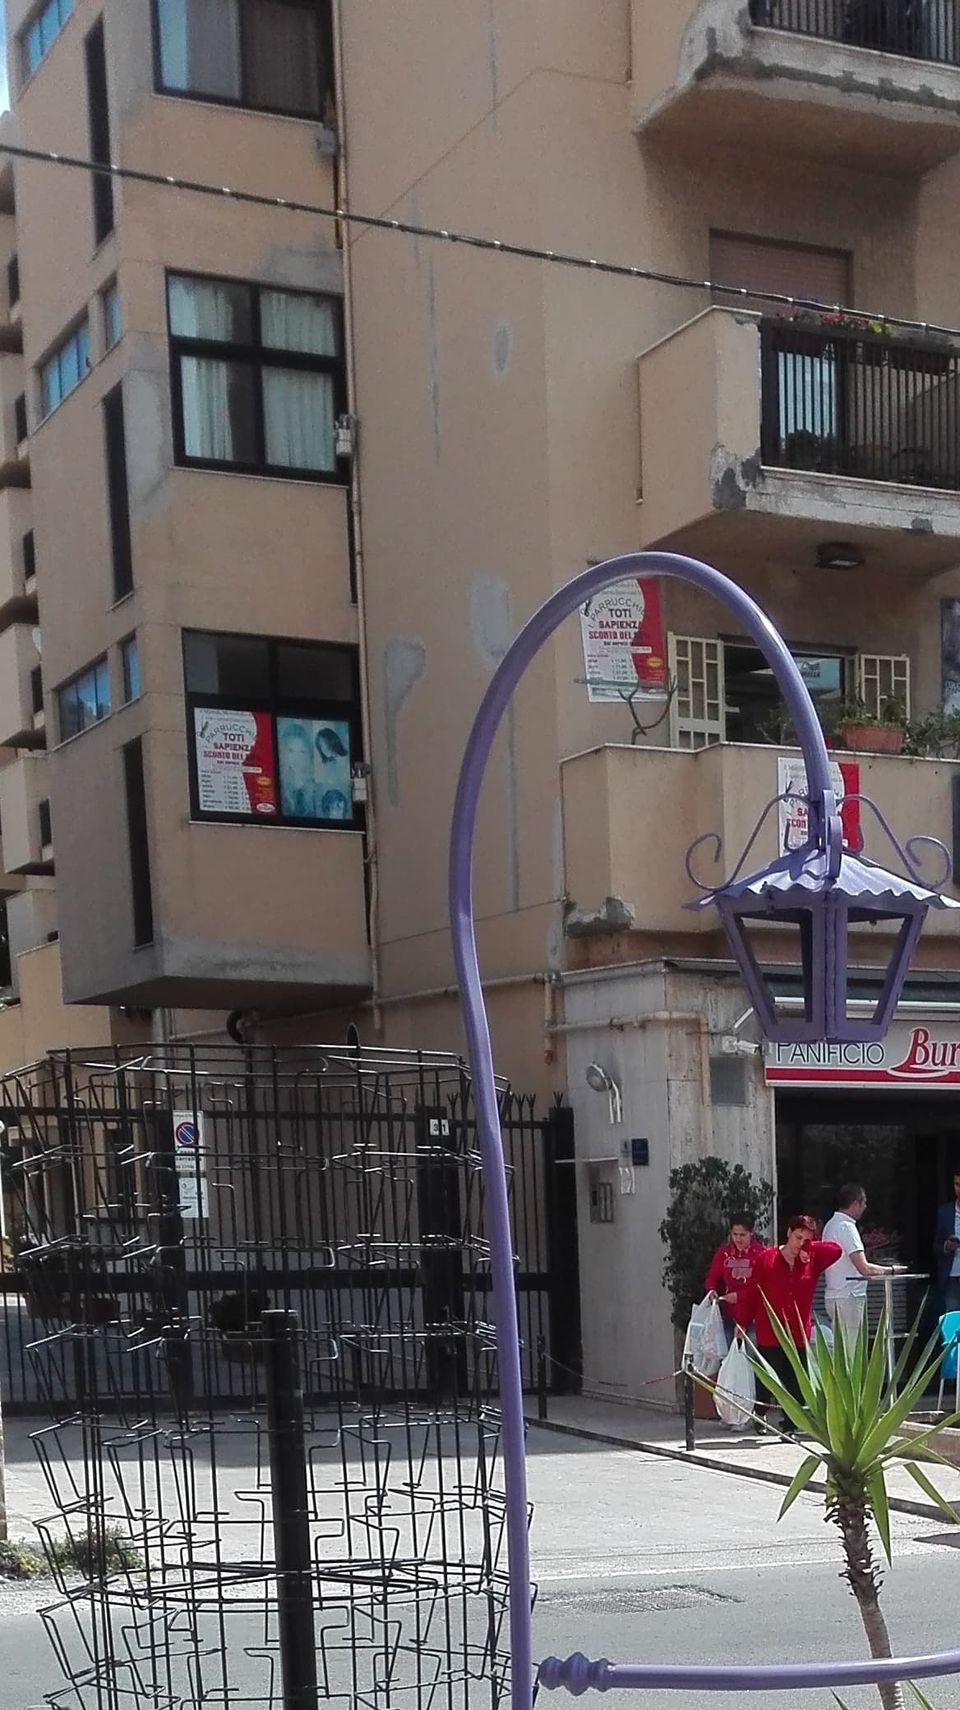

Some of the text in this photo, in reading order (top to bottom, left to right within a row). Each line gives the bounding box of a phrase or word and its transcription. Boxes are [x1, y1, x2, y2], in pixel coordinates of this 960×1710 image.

[608, 608, 632, 618] TOTI
[588, 630, 618, 640] SCONTO
[222, 732, 245, 742] TOTI
[776, 1041, 885, 1065] PANIFICIO
